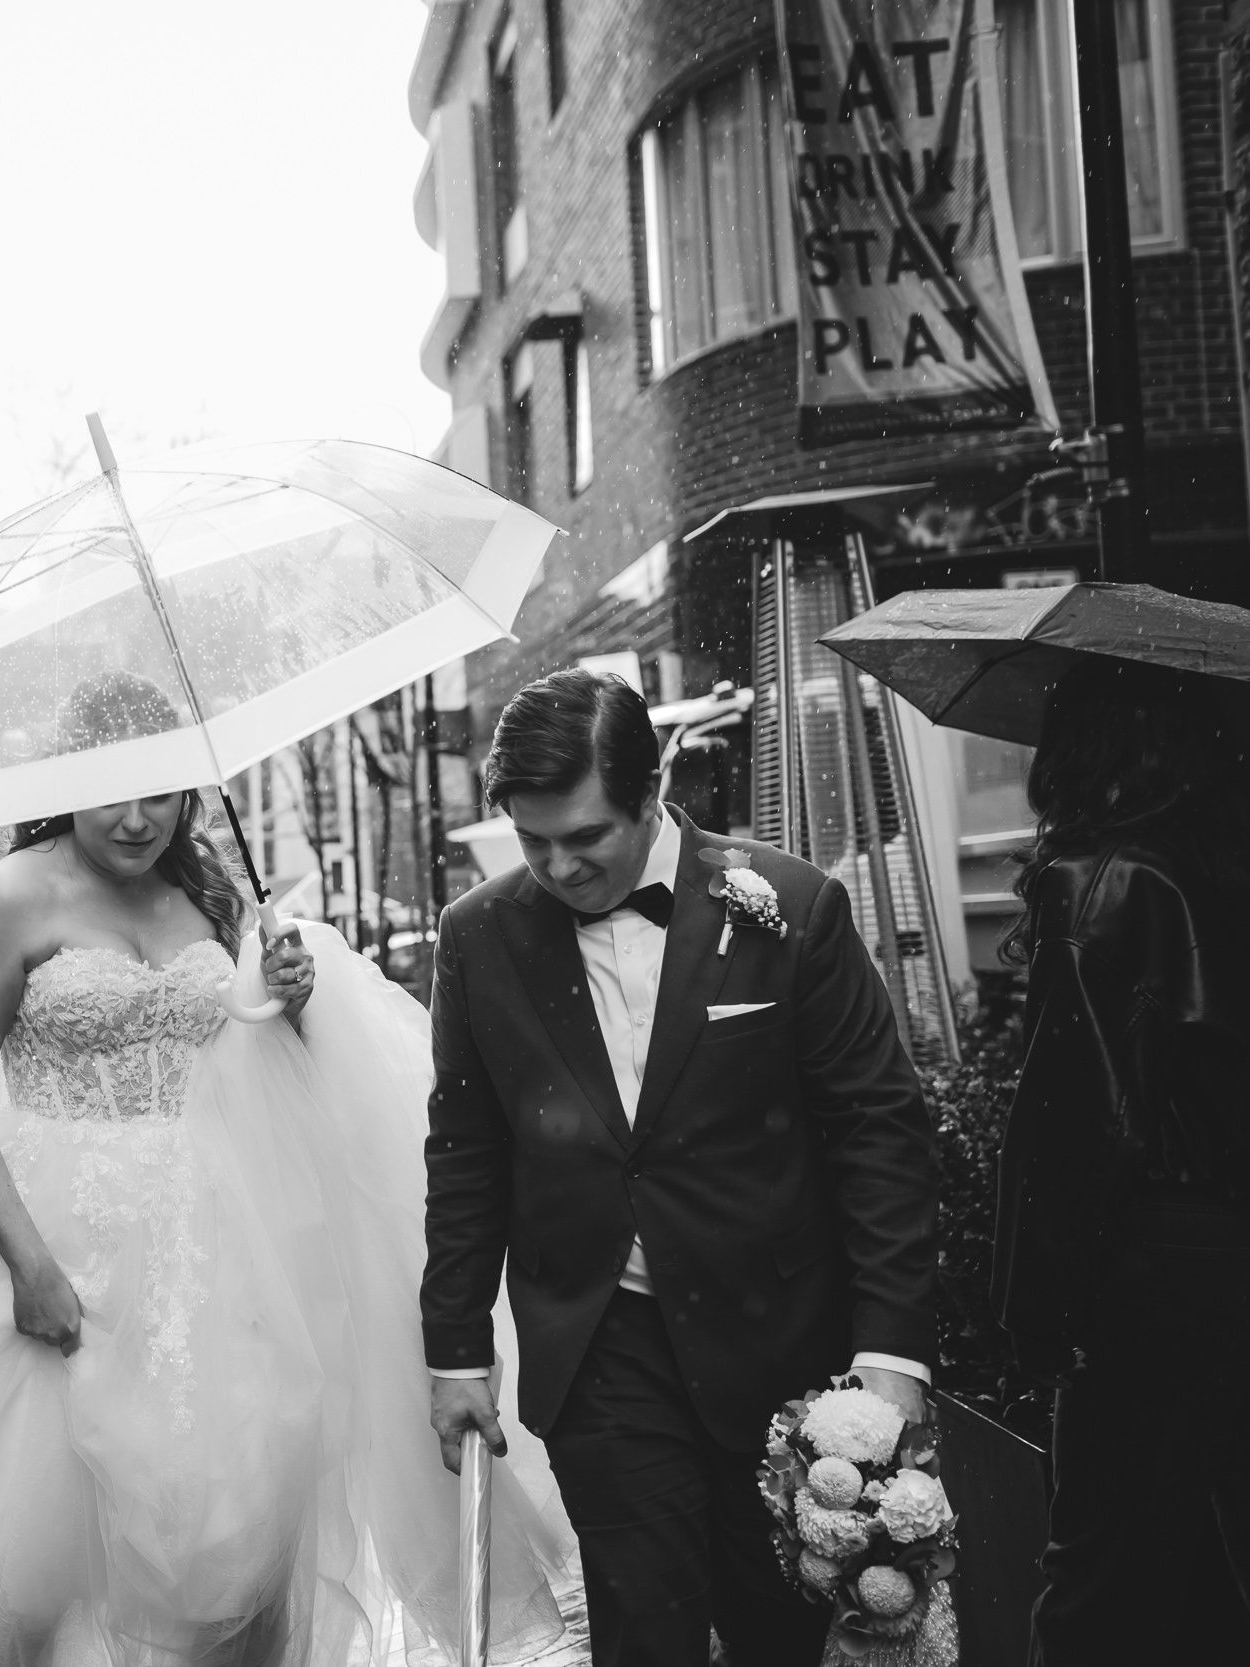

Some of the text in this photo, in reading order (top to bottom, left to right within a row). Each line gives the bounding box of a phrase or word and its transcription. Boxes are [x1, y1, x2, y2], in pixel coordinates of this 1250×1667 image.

[787, 38, 949, 123] EAT
[800, 147, 954, 200] DRINK
[806, 223, 961, 287] STAY
[814, 305, 978, 376] PLAY
